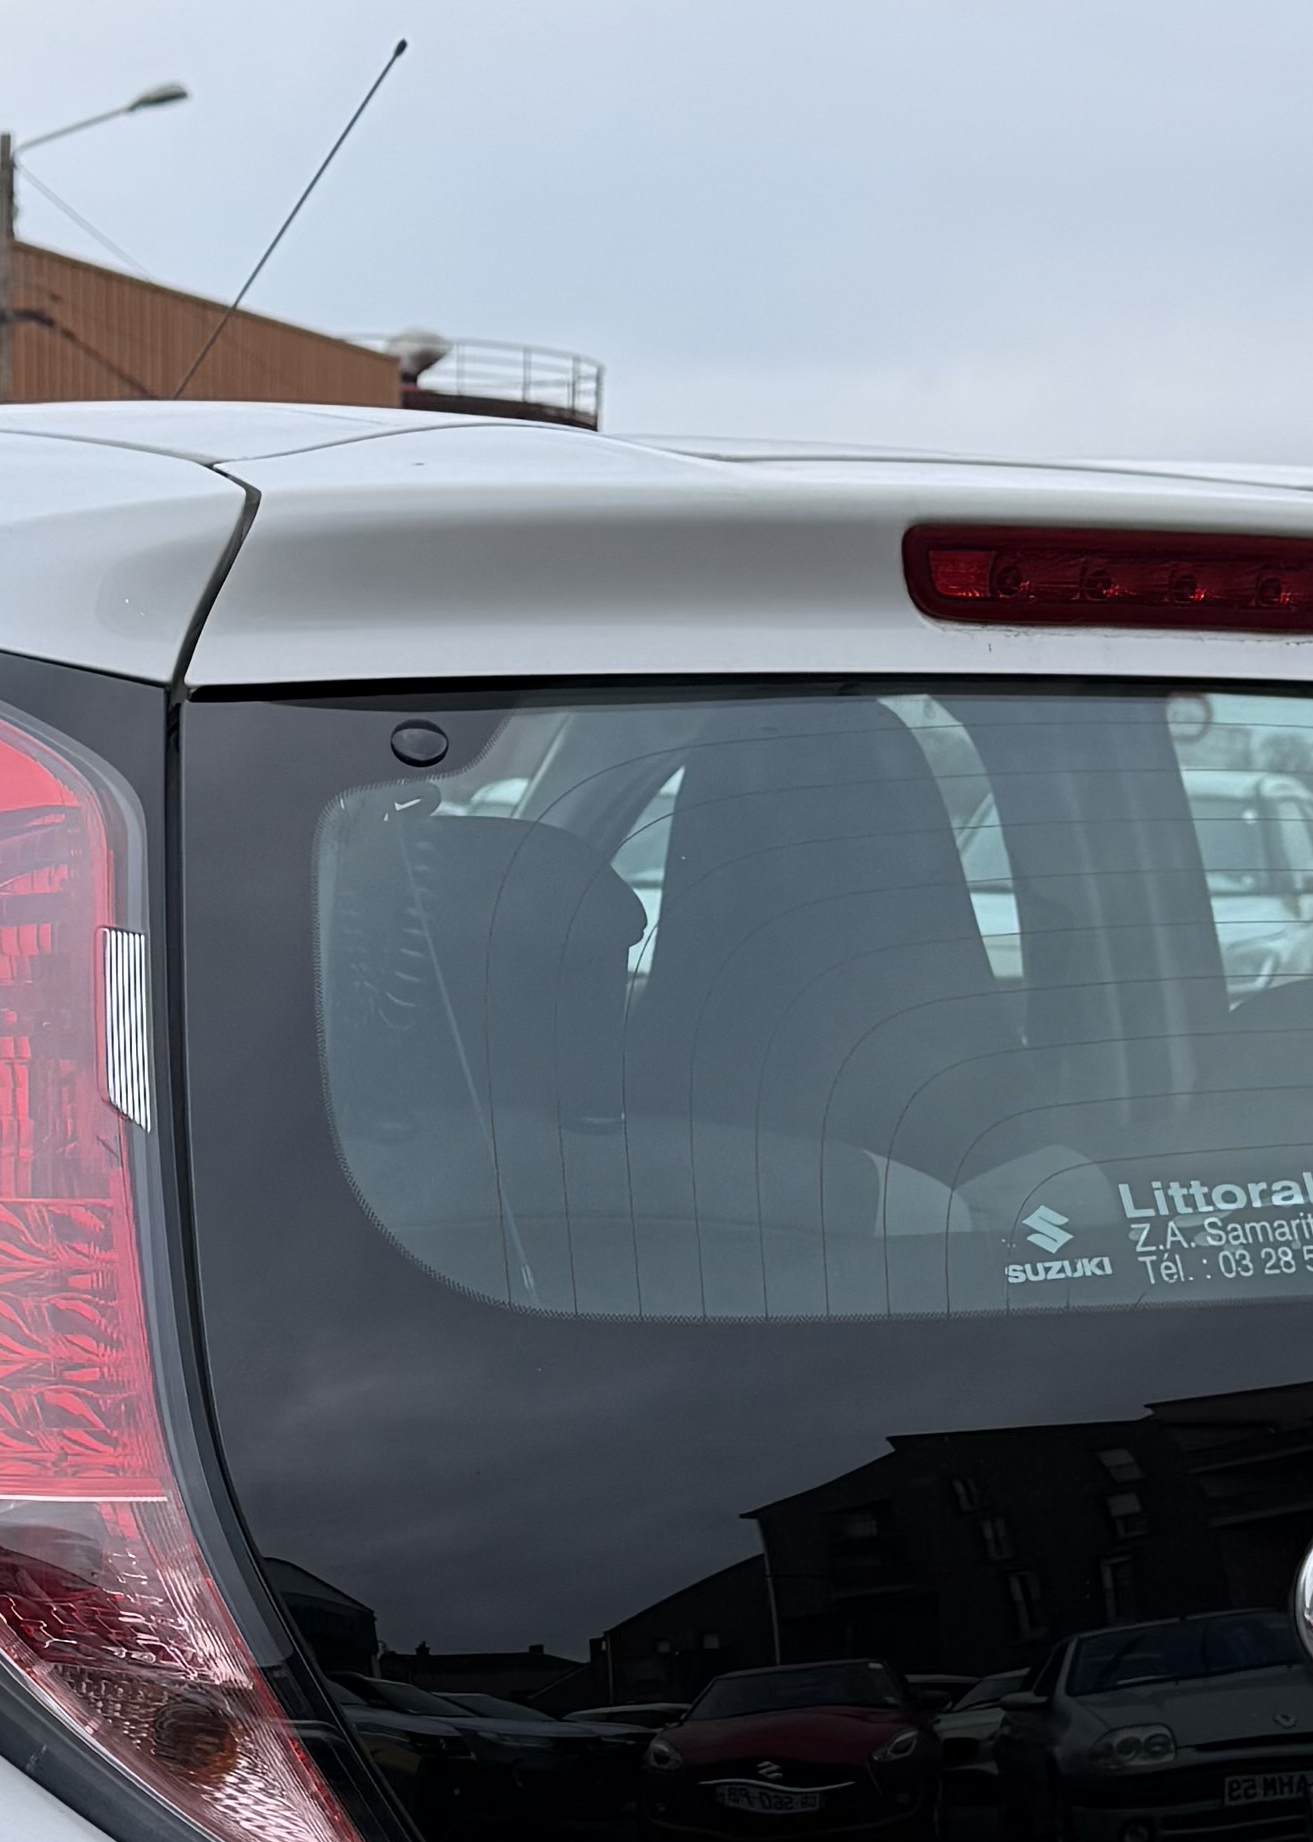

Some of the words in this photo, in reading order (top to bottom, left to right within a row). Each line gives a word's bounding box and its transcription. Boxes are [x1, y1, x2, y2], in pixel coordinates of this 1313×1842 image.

[1131, 1221, 1196, 1252] Z.A.
[1005, 1257, 1113, 1283] SUZUKI
[1218, 1250, 1254, 1279] 03
[1261, 1246, 1296, 1274] 28
